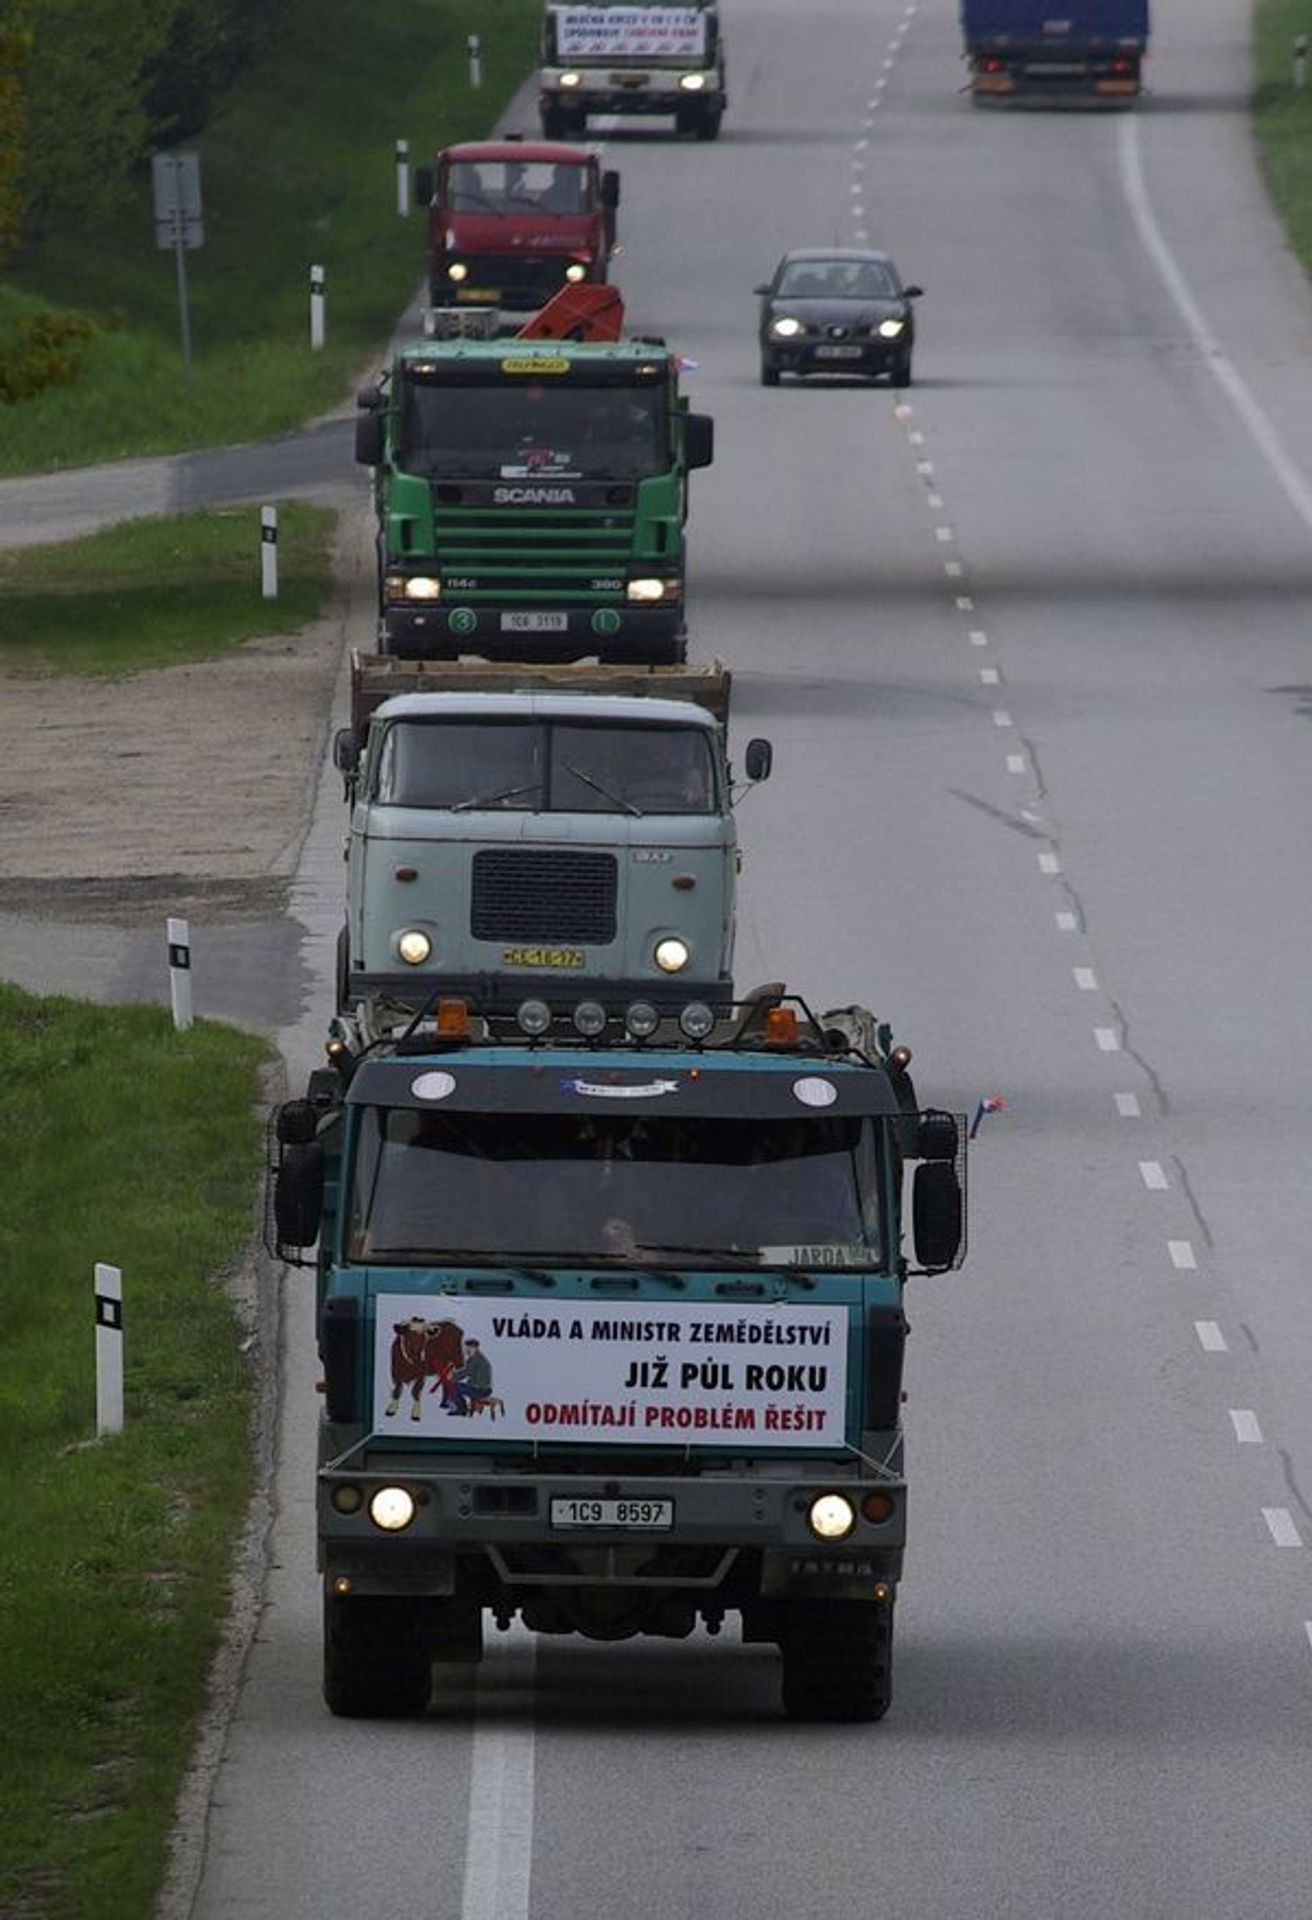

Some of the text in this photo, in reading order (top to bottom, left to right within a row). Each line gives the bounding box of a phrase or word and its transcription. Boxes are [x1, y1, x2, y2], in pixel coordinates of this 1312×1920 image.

[494, 487, 576, 504] SCANIA
[788, 1247, 846, 1265] JARDA
[492, 1313, 831, 1346] VLÁDA A MINISTR ZEMĚDĚLSTVÍ
[624, 1355, 828, 1393] JIŽ PŮL ROKU
[525, 1399, 827, 1431] ODMÍTAJÍ PROBLÉM ŘEŠIT
[569, 1502, 664, 1523] 1C9 8597
